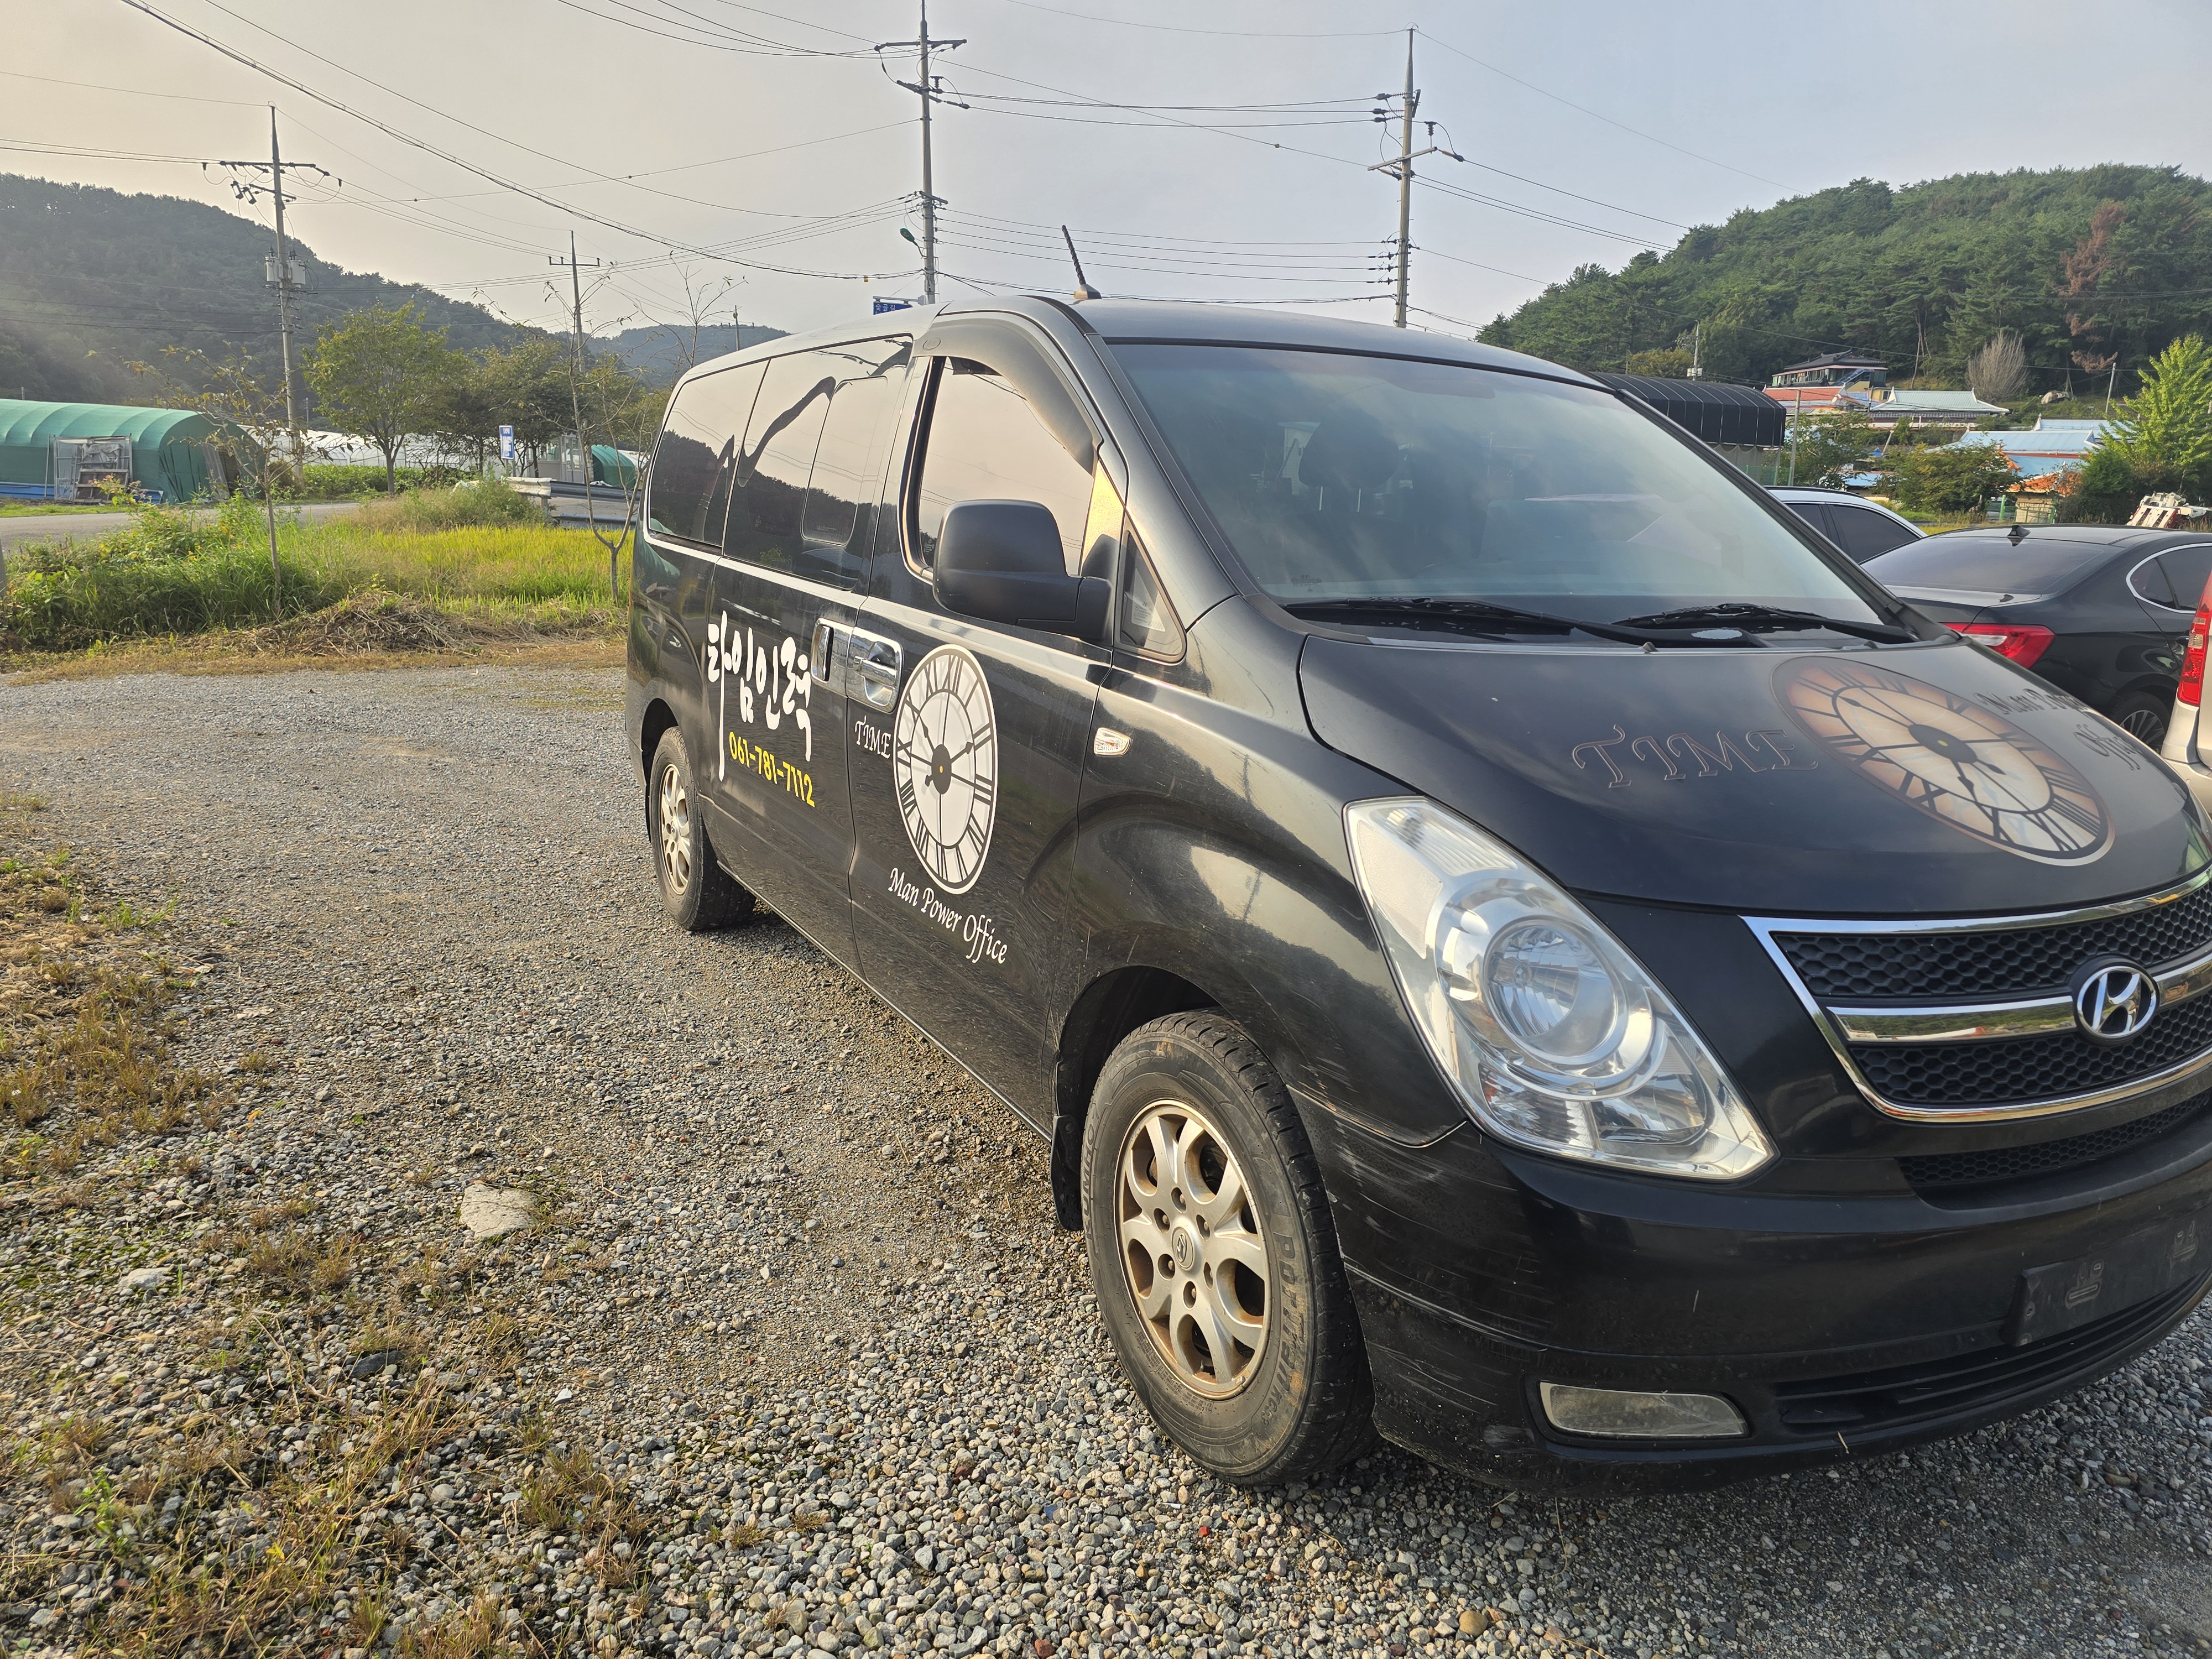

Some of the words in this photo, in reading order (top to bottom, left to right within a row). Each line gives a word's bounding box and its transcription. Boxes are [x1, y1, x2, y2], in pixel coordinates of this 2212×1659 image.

[728, 731, 816, 808] 061-781-7112
[854, 715, 891, 759] TIME
[1572, 724, 1819, 789] TIME
[888, 867, 919, 906] Man
[921, 888, 963, 932] Power
[963, 914, 1008, 964] Office
[1082, 1123, 1095, 1240] KUMHO
